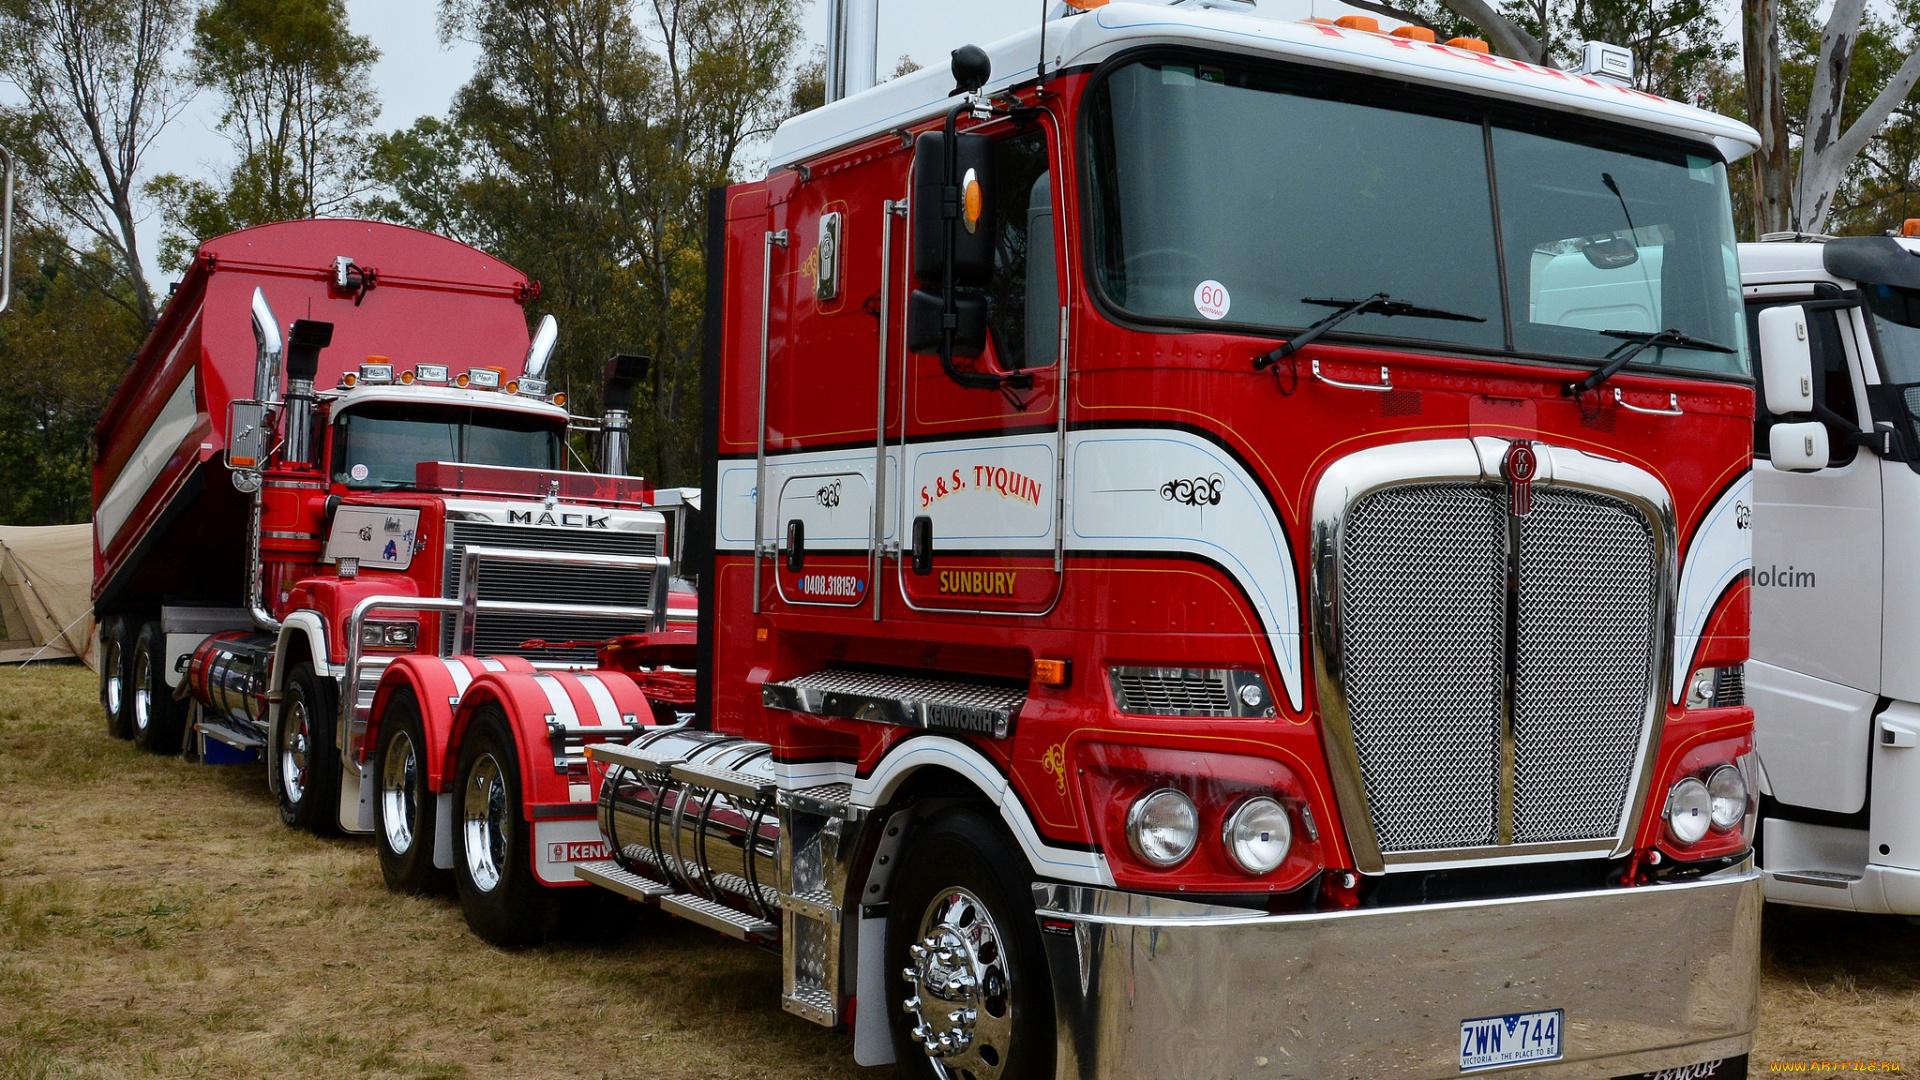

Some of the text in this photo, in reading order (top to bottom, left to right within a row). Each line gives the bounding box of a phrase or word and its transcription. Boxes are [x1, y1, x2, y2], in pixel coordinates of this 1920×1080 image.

[1201, 285, 1224, 307] 60
[921, 465, 1042, 507] S. & S. TYQUIN
[506, 508, 611, 530] MACK
[804, 575, 856, 597] 0408.318152
[940, 571, 1016, 594] SUNBURY
[1752, 565, 1816, 588] olcim
[927, 704, 993, 733] KENWORTH
[1463, 1017, 1555, 1057] ZWN 744
[1462, 1055, 1492, 1065] VICTORIA
[1501, 1052, 1513, 1060] THE
[1515, 1050, 1534, 1059] PLACE
[1536, 1048, 1545, 1056] TO
[1547, 1046, 1555, 1055] BE
